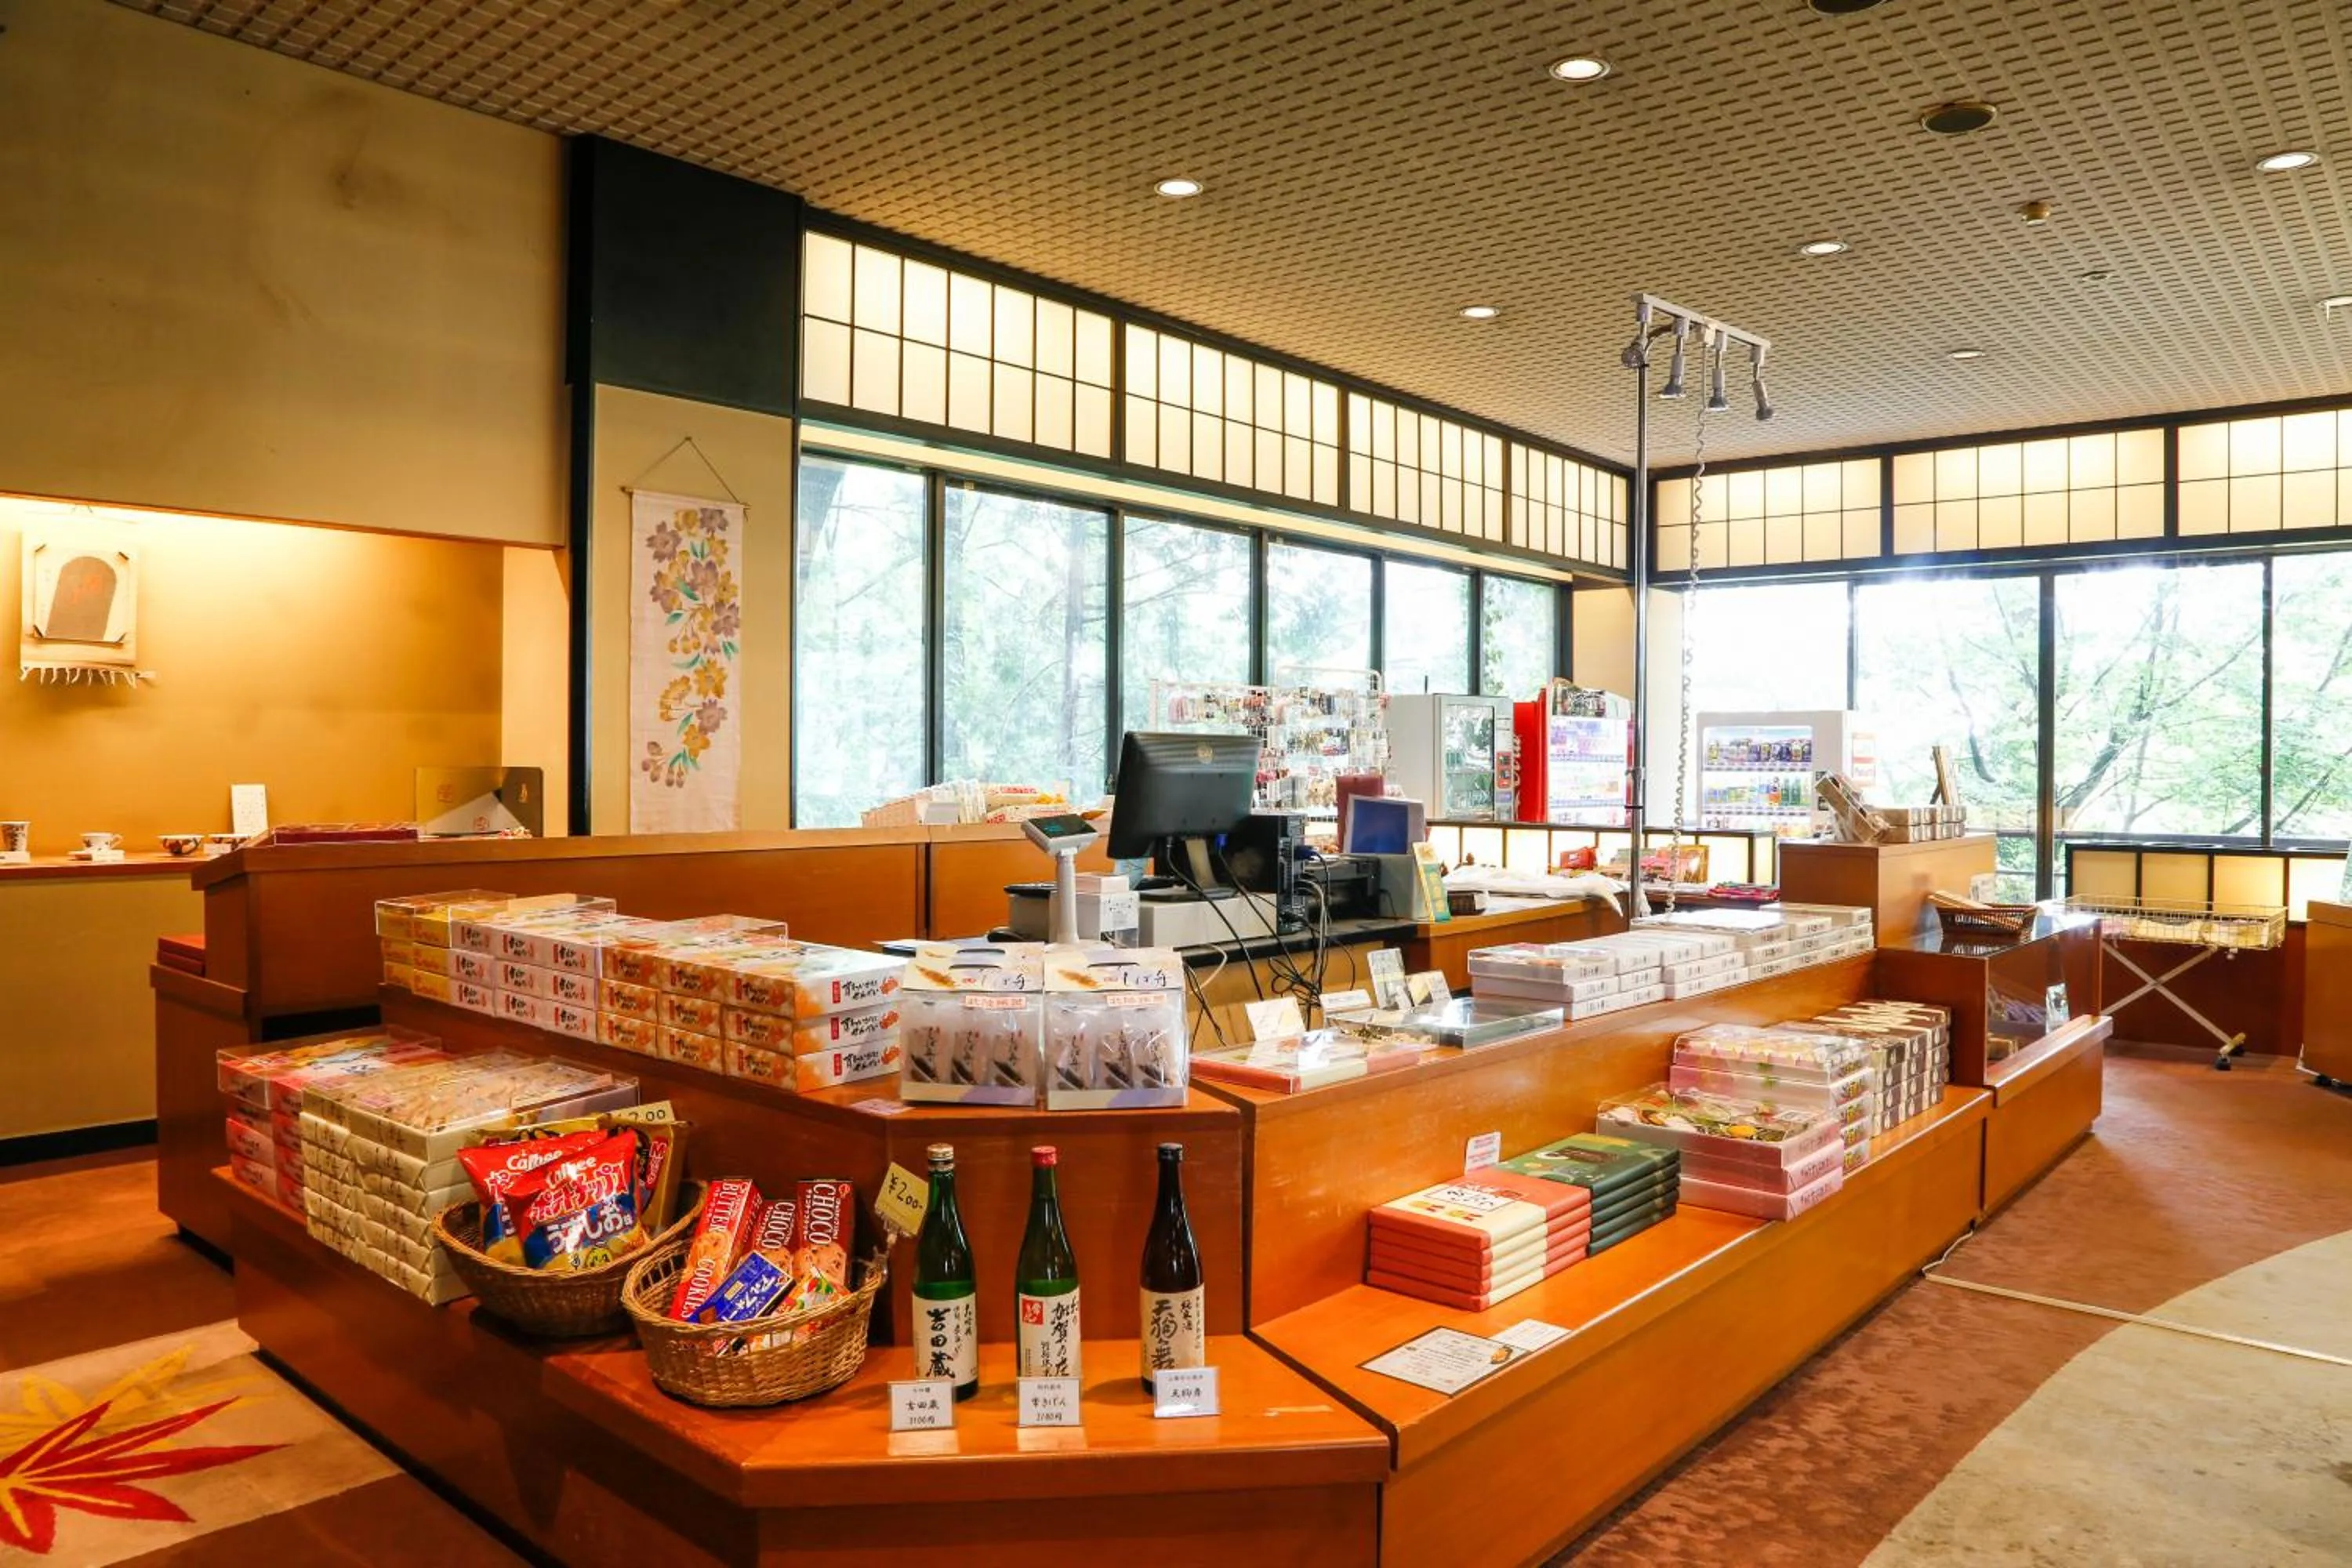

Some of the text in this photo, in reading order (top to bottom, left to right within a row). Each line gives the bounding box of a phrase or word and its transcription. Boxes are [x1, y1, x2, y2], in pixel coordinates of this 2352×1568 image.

[708, 1182, 739, 1232] BUTTER
[761, 1201, 796, 1249] CHOCO
[808, 1183, 836, 1245] CHOCO
[681, 1258, 716, 1318] COOKIES
[926, 1308, 955, 1378] 吉田蔵
